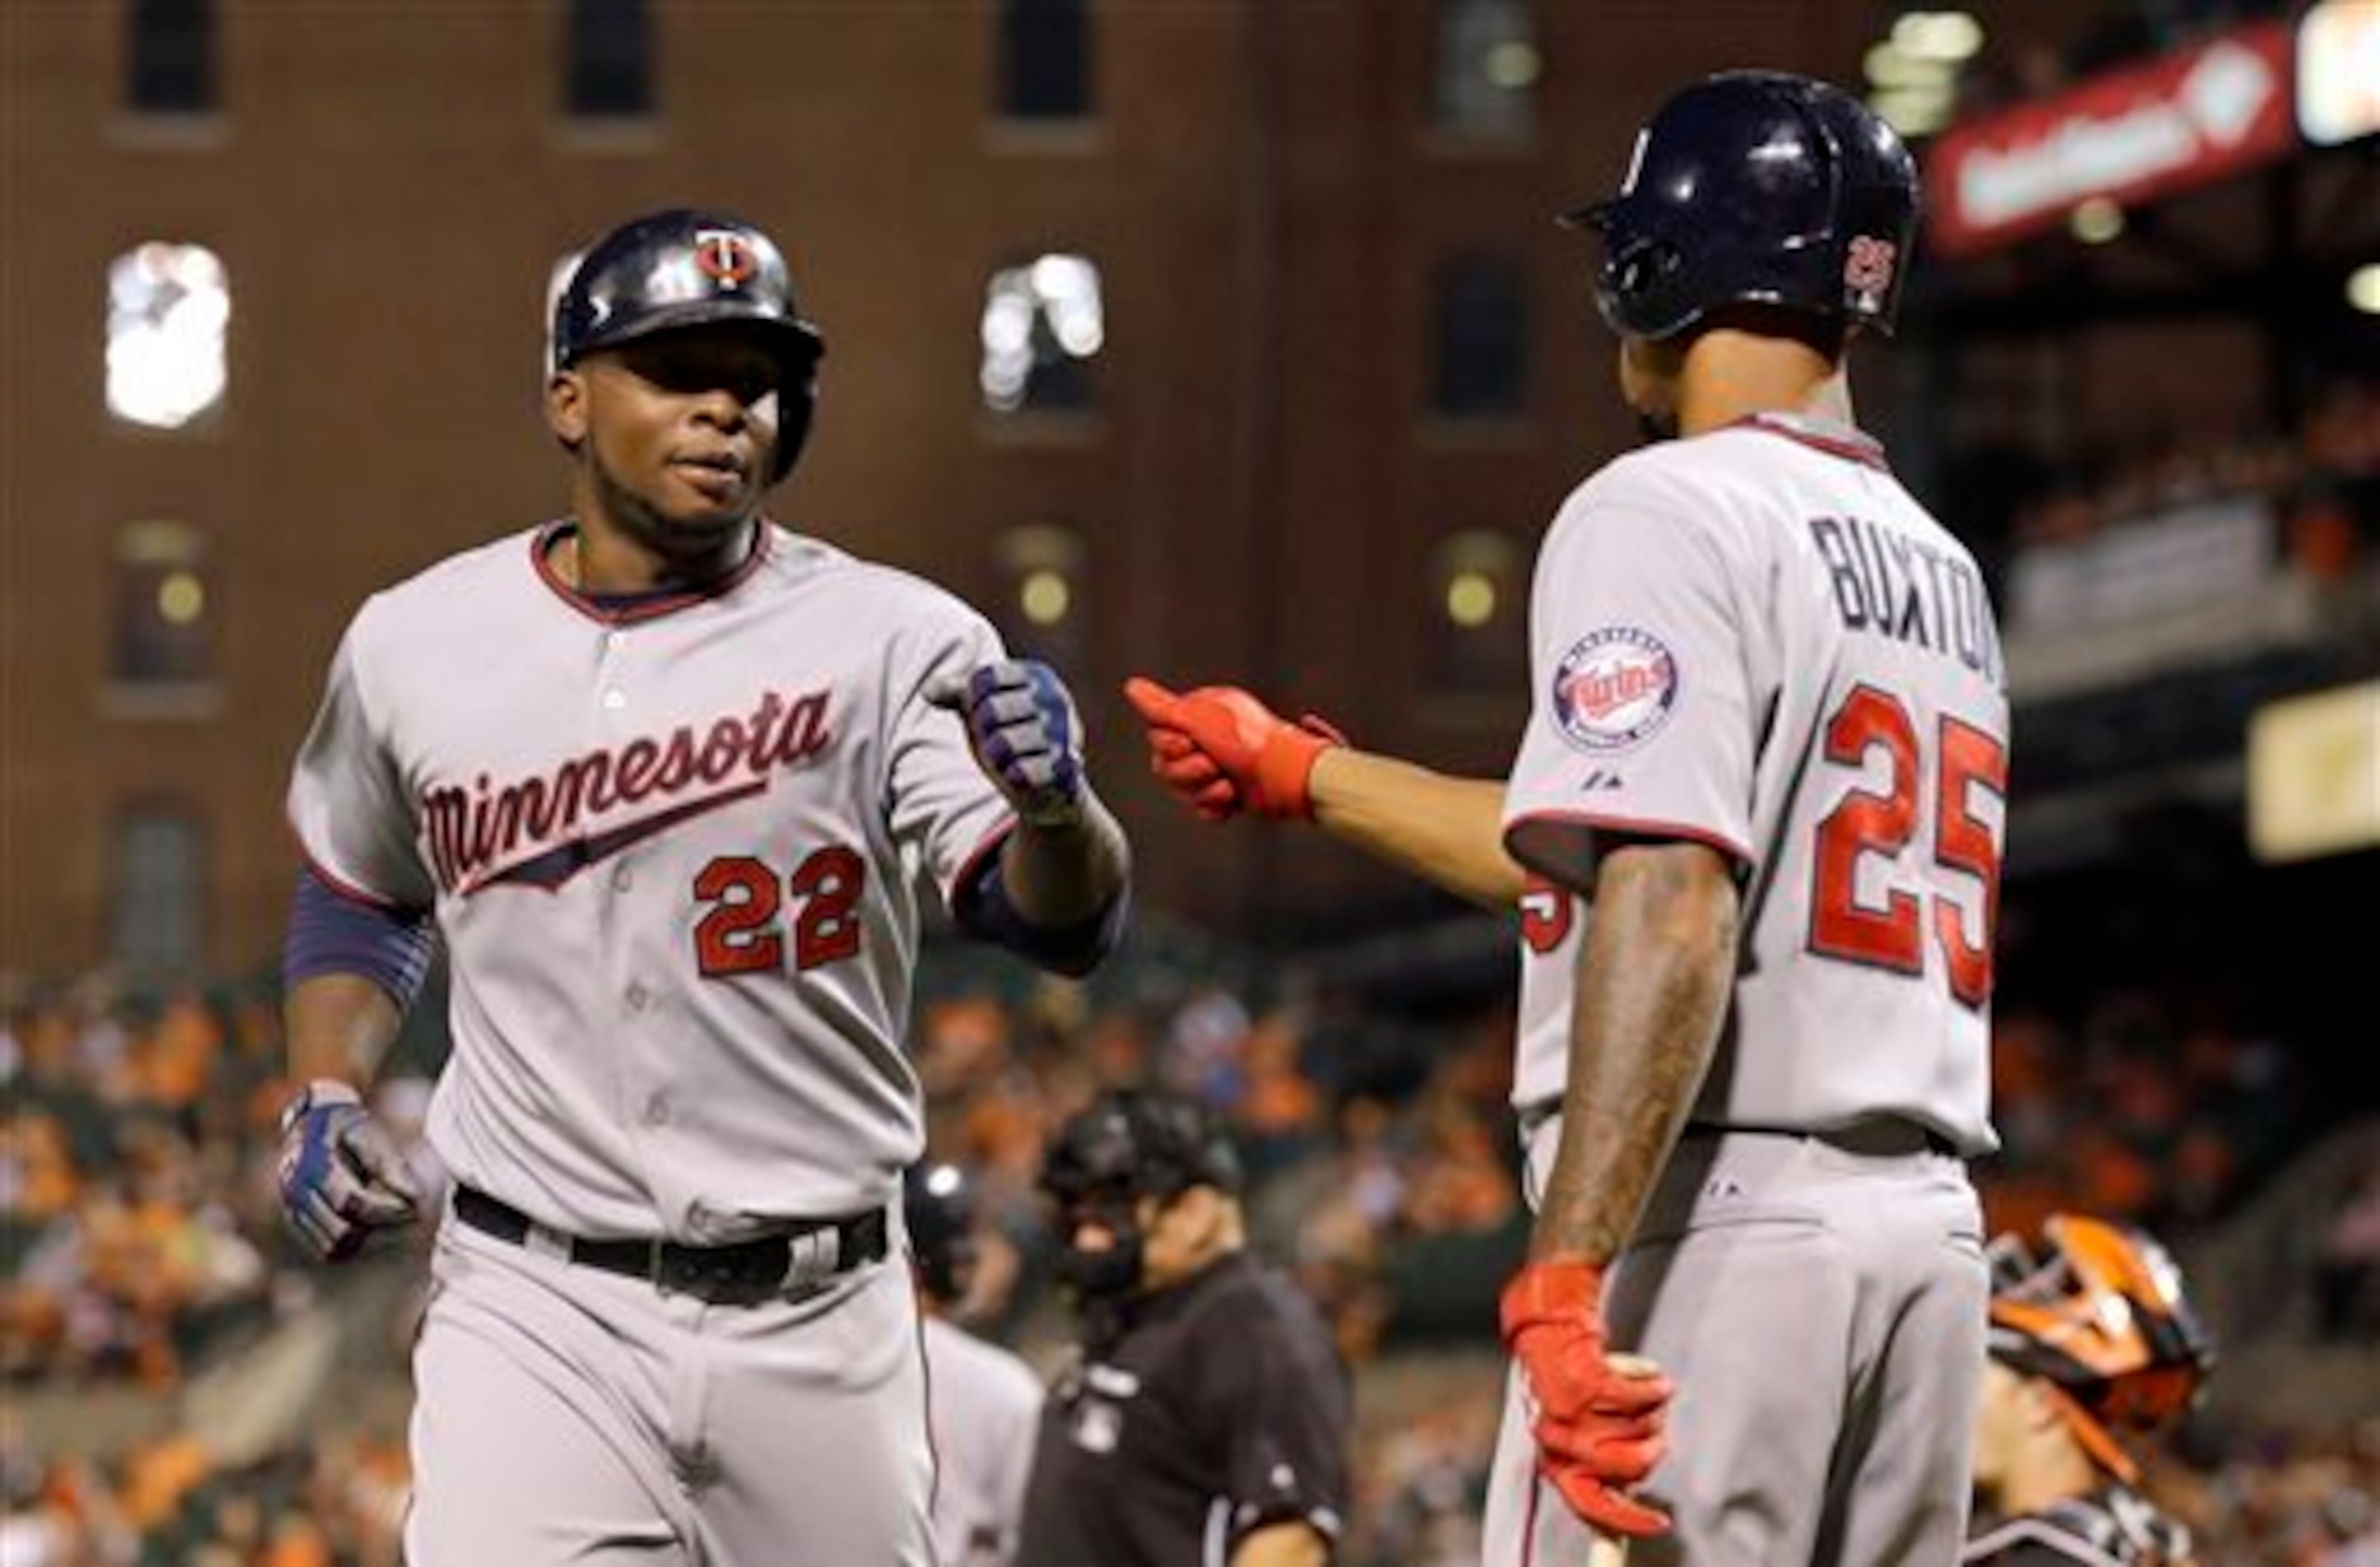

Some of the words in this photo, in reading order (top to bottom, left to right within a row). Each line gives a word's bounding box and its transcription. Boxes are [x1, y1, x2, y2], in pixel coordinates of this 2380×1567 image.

[423, 689, 832, 896] Minnesota
[1805, 682, 2006, 1010] 25
[693, 843, 866, 978] 22
